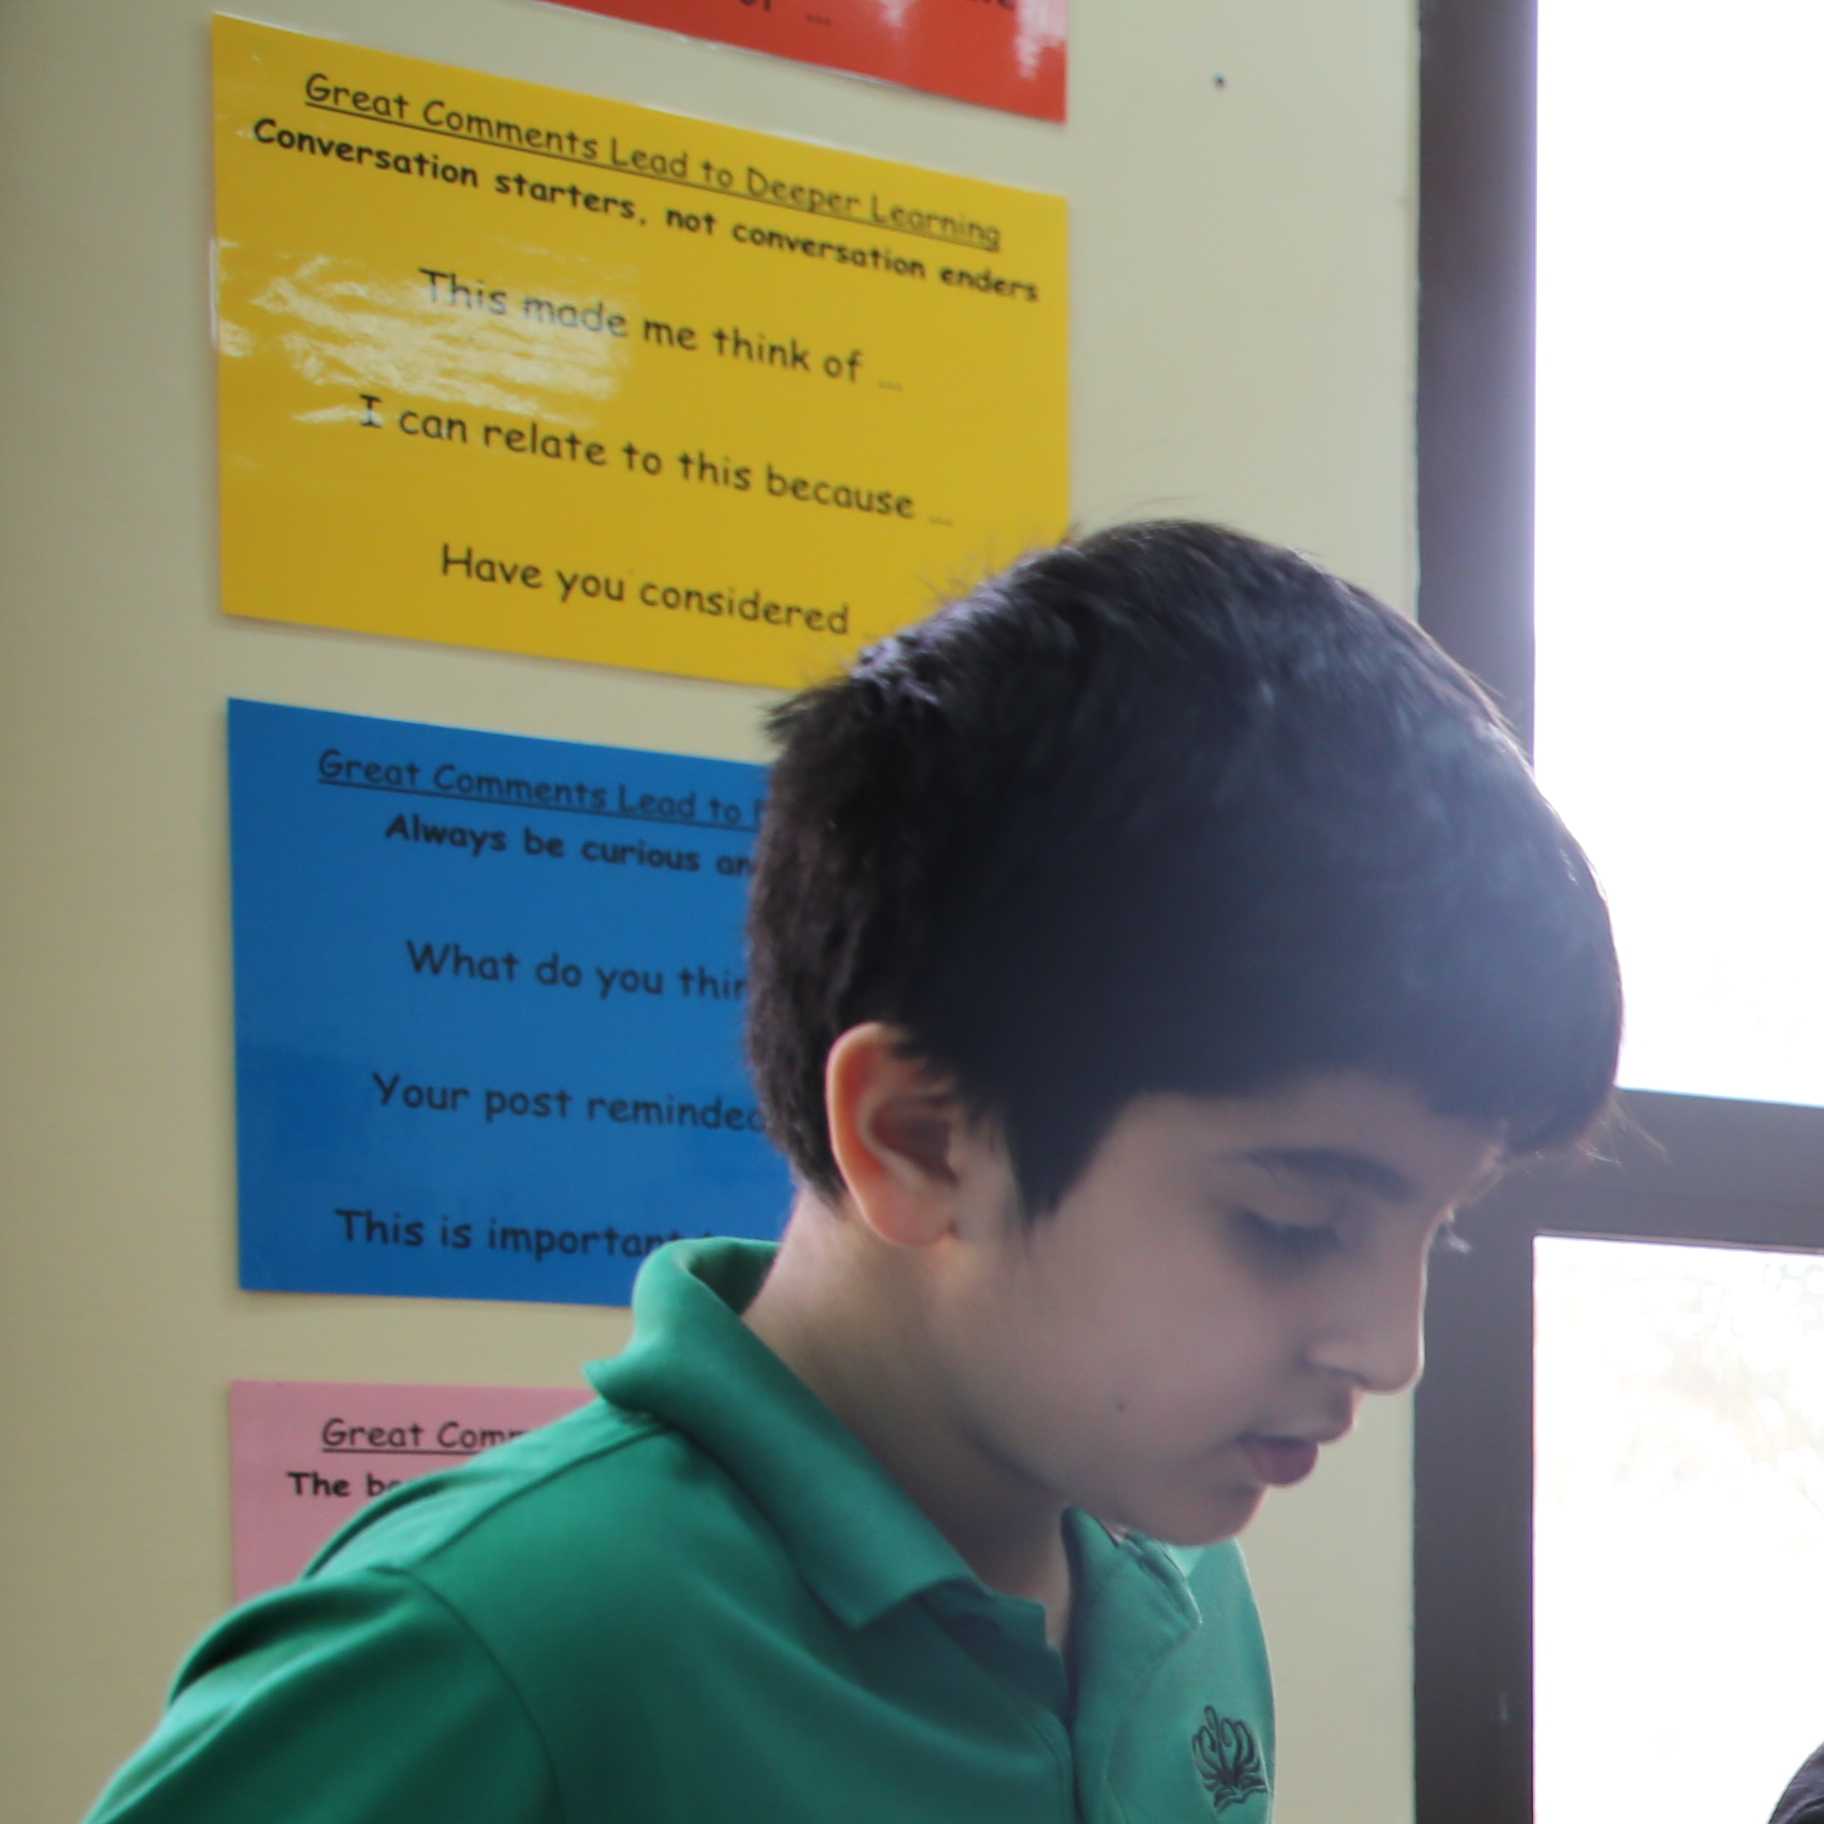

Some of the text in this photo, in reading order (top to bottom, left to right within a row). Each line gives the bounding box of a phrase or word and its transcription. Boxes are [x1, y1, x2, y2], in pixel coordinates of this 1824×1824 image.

[305, 72, 1001, 250] Great Comments Lead to Deeper Learning
[252, 118, 1041, 303] Conversation starters, not conversation enders
[418, 268, 864, 385] This made me think of
[359, 394, 916, 520] I can relate to this because
[440, 545, 850, 637] Have you considered
[318, 748, 421, 787] Great
[433, 763, 607, 810] Comments
[617, 783, 696, 821] Lead
[708, 798, 742, 828] to
[385, 813, 756, 878] Always be curious an
[405, 939, 750, 1000] What do you thin
[372, 1072, 470, 1111] Your
[484, 1086, 572, 1122] post
[335, 1207, 677, 1262] This is importan
[321, 1418, 424, 1449] Great
[286, 1472, 351, 1497] The
